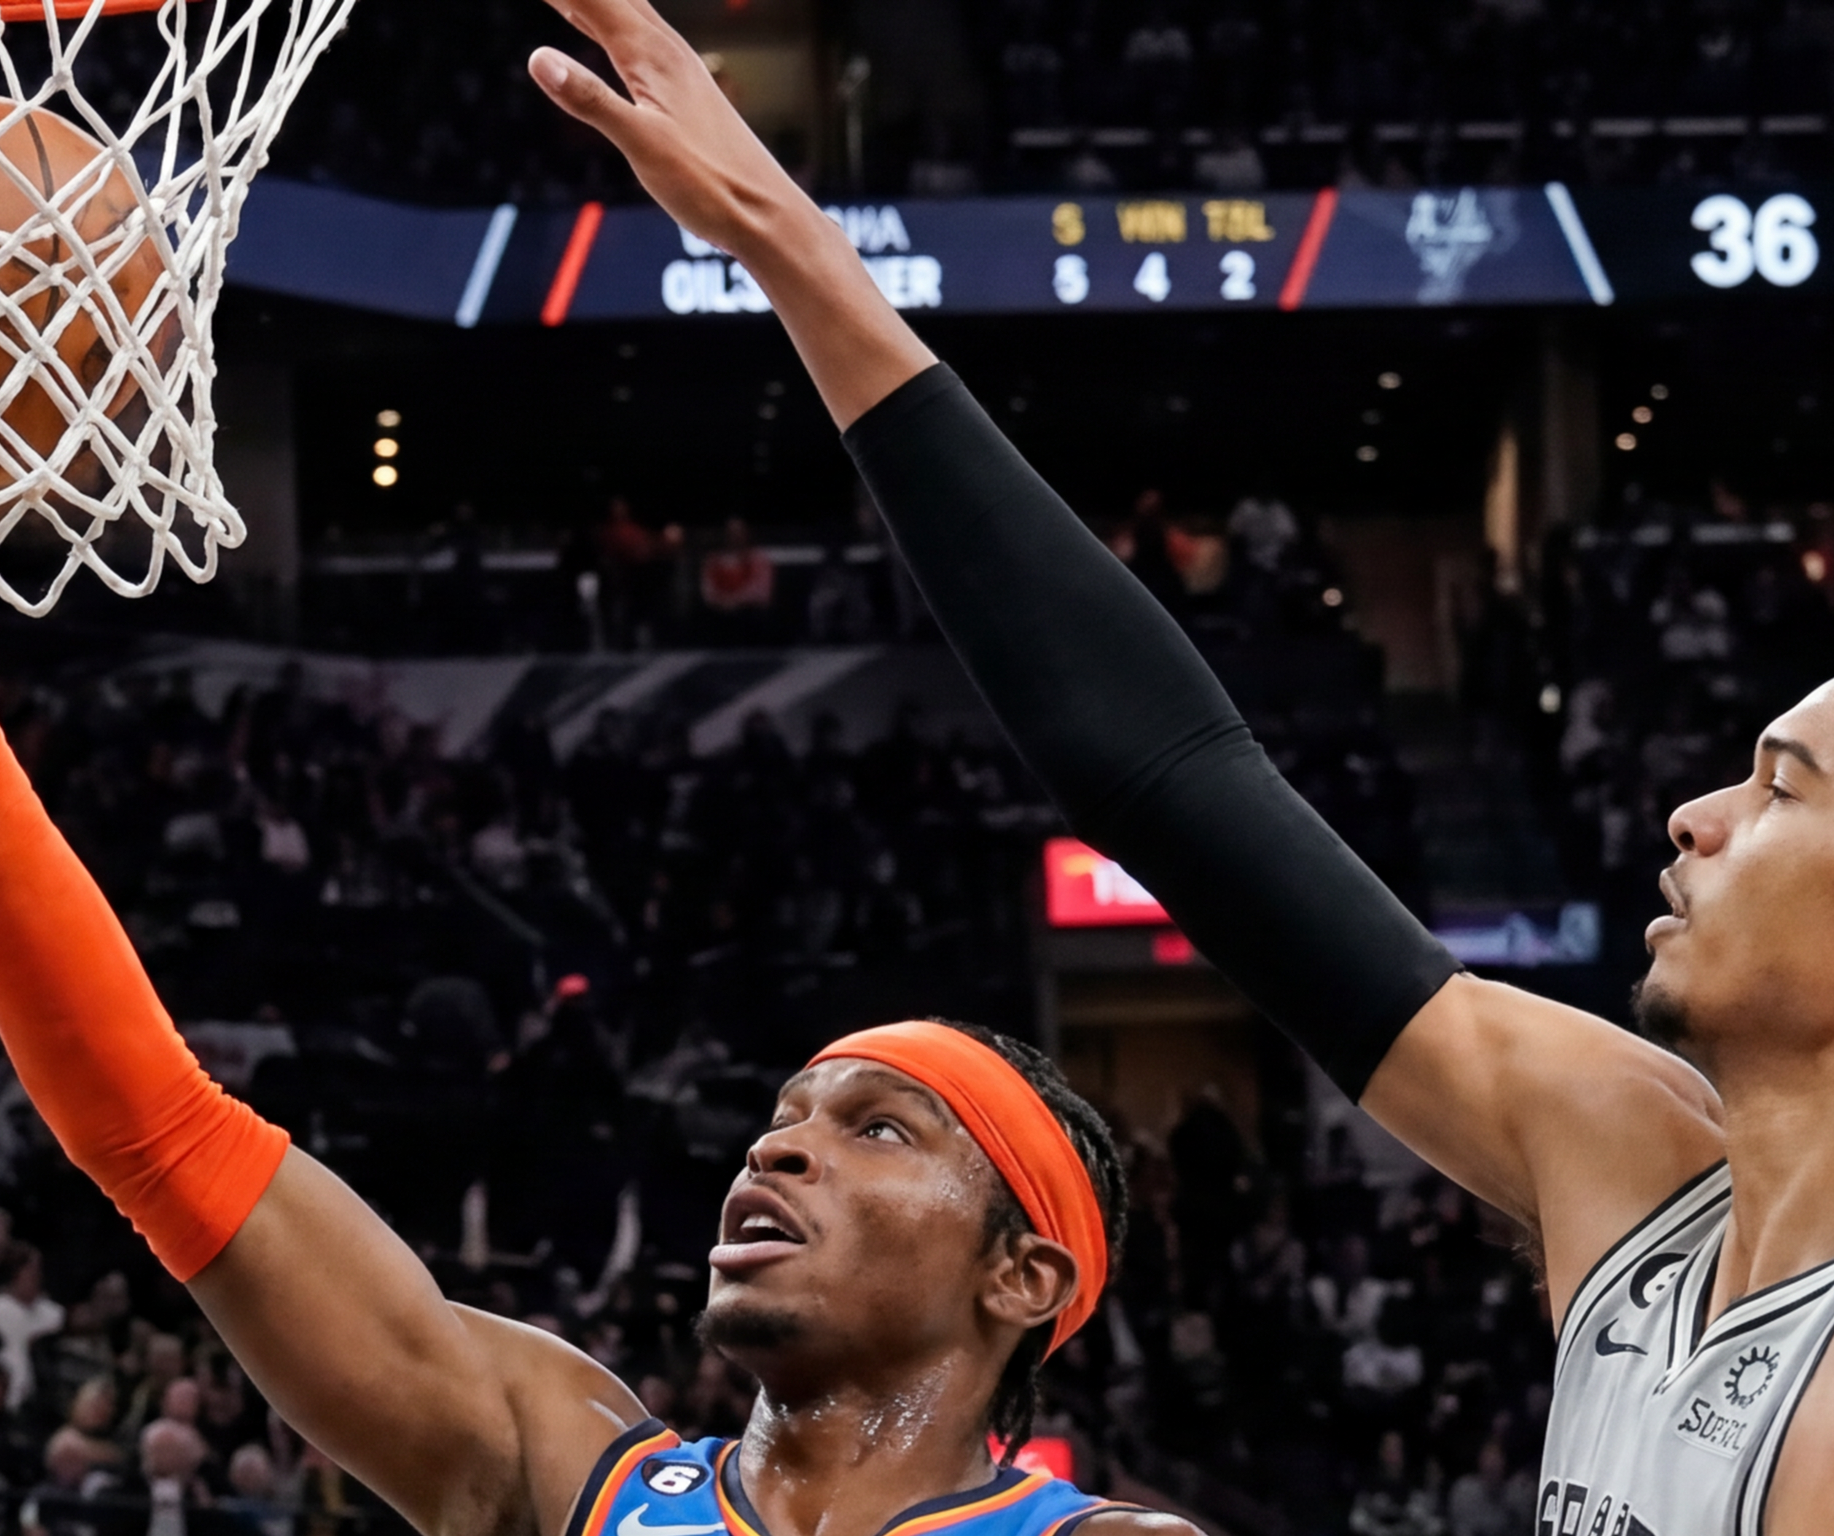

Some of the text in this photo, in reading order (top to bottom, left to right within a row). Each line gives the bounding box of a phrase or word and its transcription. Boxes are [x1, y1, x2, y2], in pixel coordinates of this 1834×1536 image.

[1691, 194, 1819, 288] 36
[1134, 252, 1171, 302] 4
[1220, 250, 1256, 300] 2
[649, 1465, 700, 1495] 6
